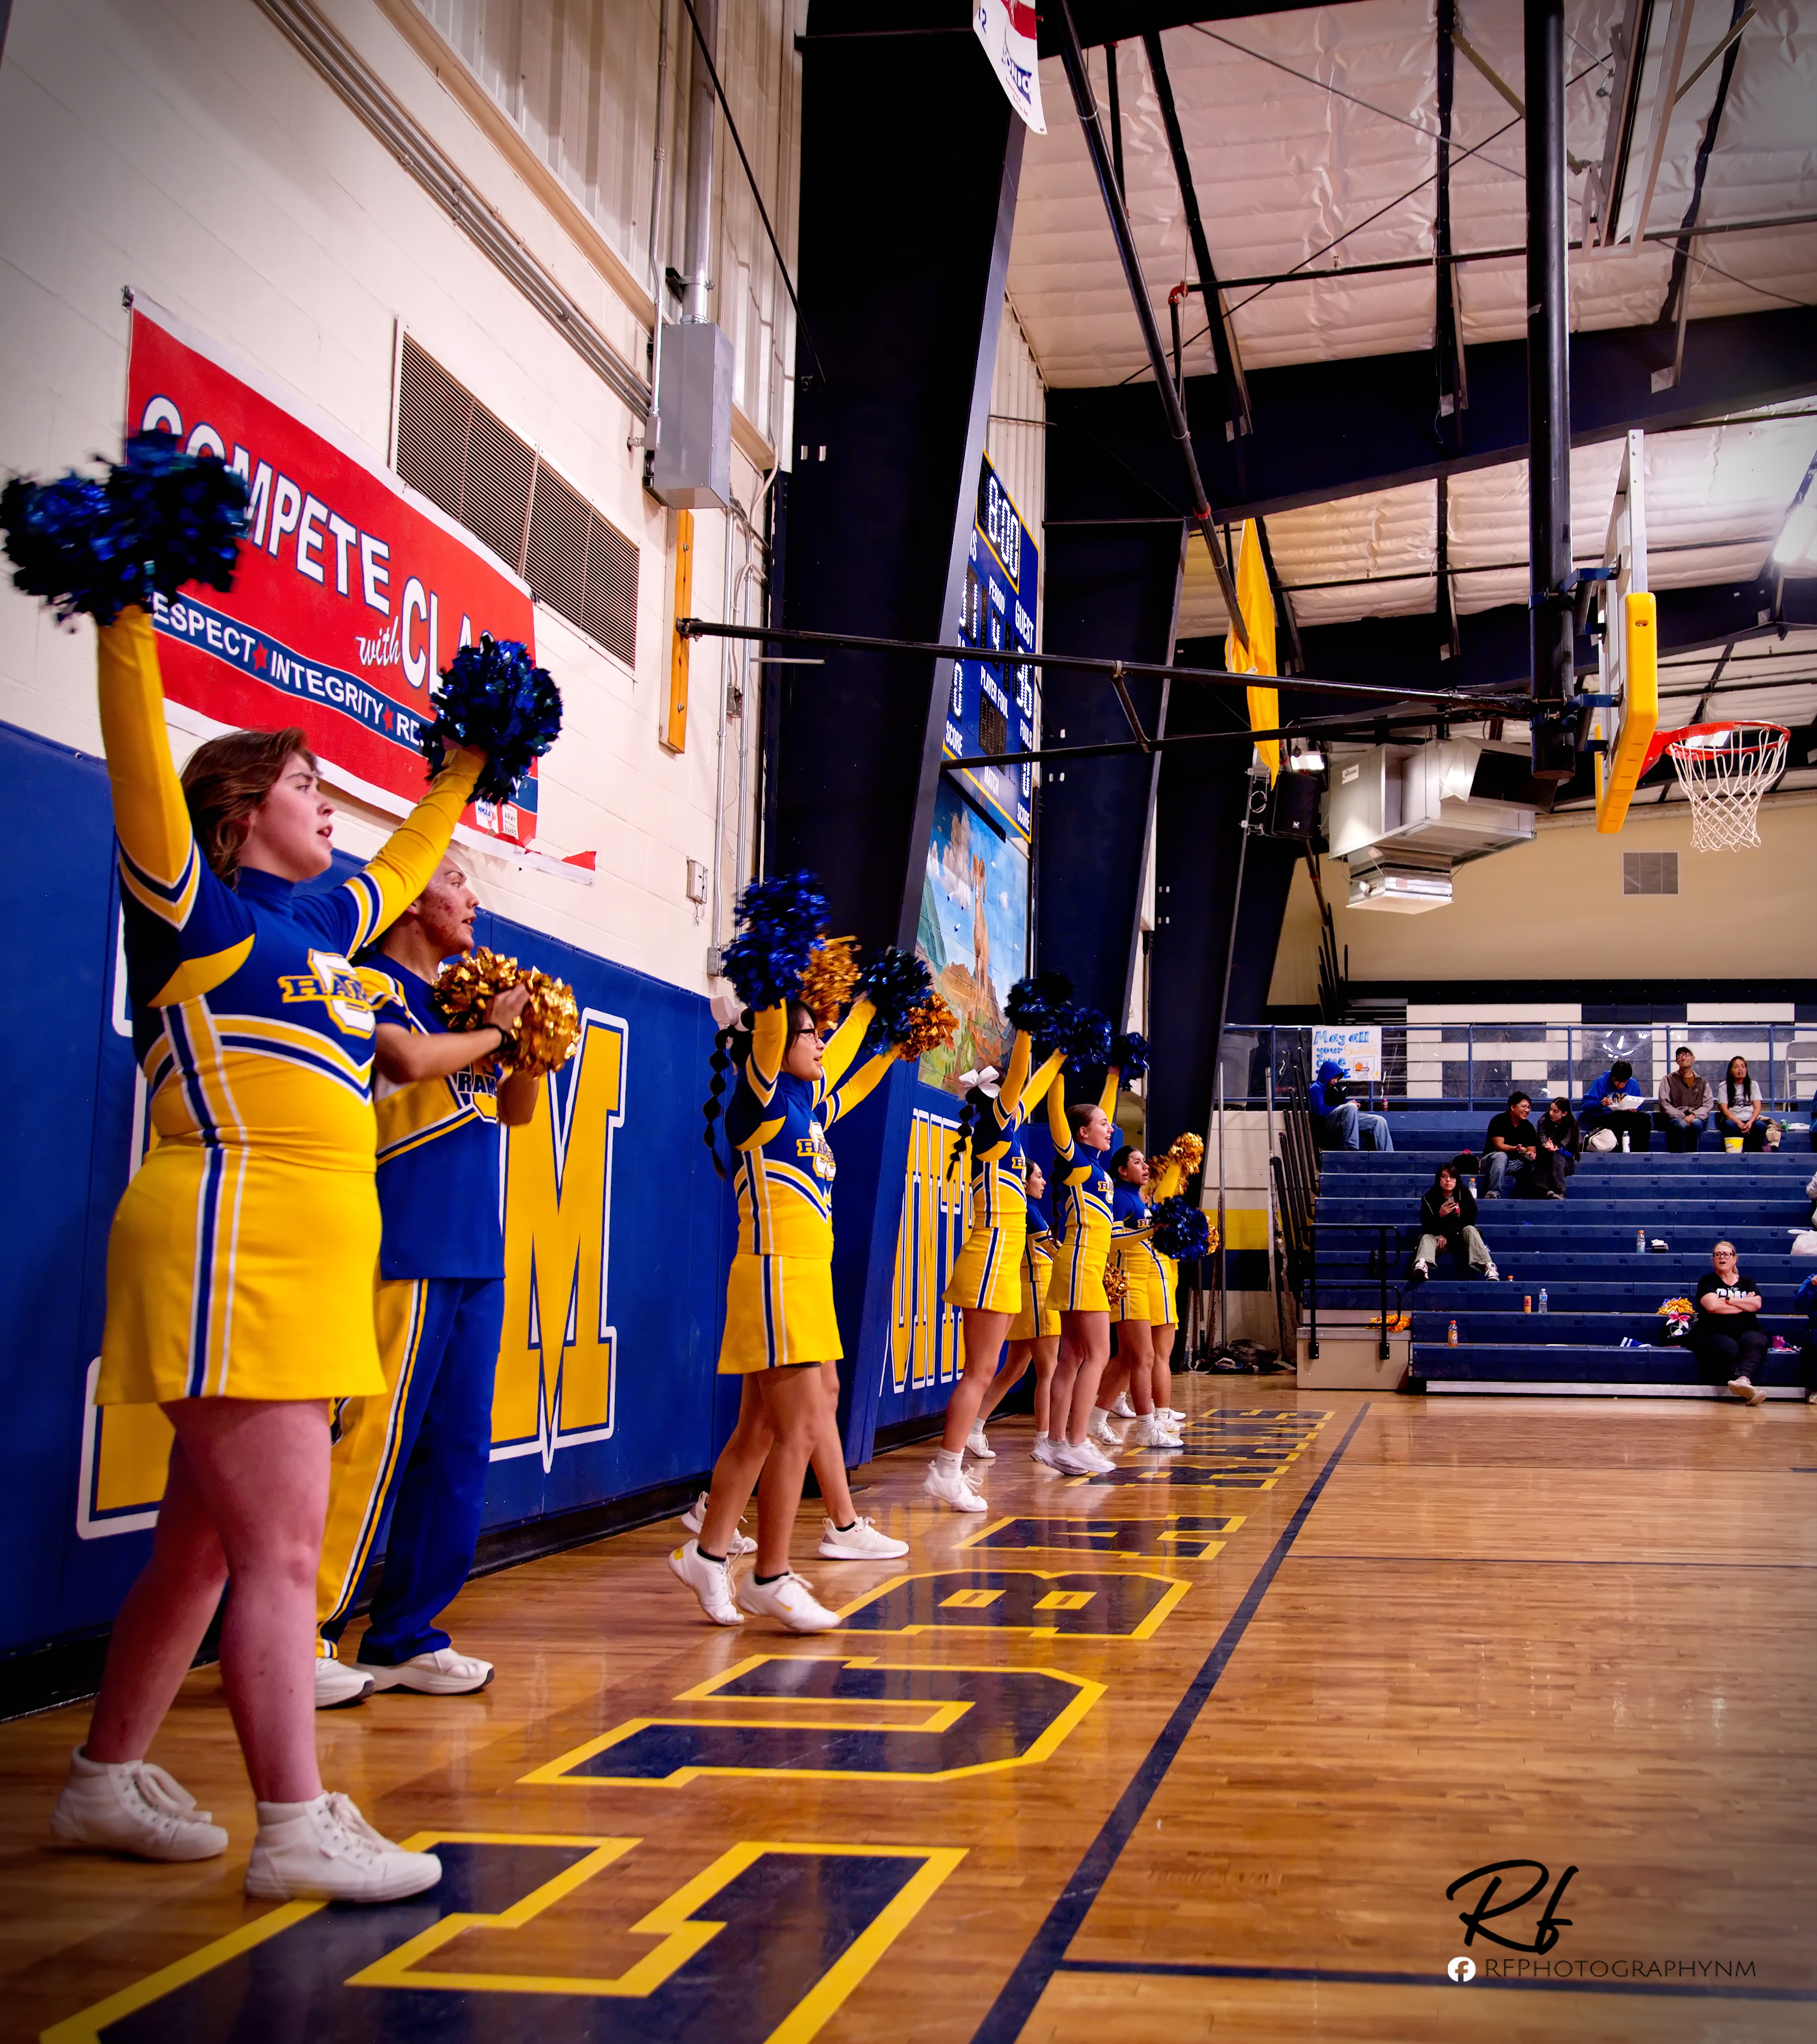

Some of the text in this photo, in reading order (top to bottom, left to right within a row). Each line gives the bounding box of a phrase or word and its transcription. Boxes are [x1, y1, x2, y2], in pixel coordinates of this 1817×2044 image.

[989, 574, 1005, 615] PERIOD
[355, 615, 401, 667] with
[1014, 599, 1034, 649] GUEST
[146, 591, 384, 724] ESPECT INTEGRITY
[981, 664, 1008, 720] PLAYER FOUL
[946, 720, 963, 757] SCORE
[1020, 718, 1032, 750] FOULS
[984, 766, 999, 797] MATCH
[1017, 802, 1030, 837] SCORE
[1313, 1030, 1370, 1046] May all
[1316, 1047, 1343, 1058] your
